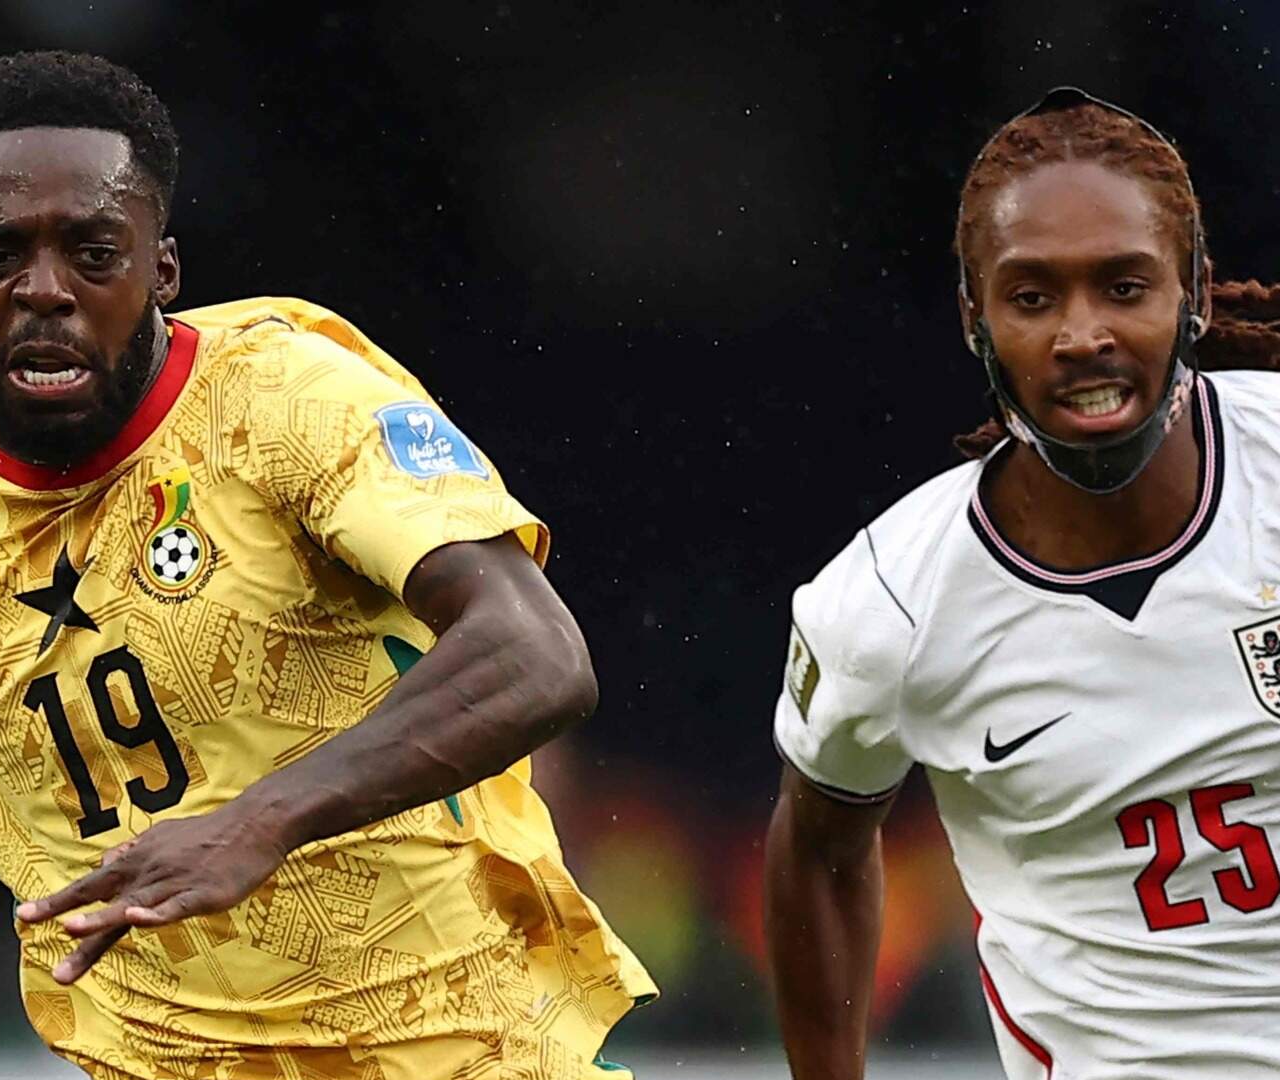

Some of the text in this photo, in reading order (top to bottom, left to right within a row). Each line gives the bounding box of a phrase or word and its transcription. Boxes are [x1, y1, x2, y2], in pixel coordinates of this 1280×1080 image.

[130, 567, 154, 598] GHANA
[153, 590, 194, 605] FOOTBALL
[23, 644, 190, 840] 19
